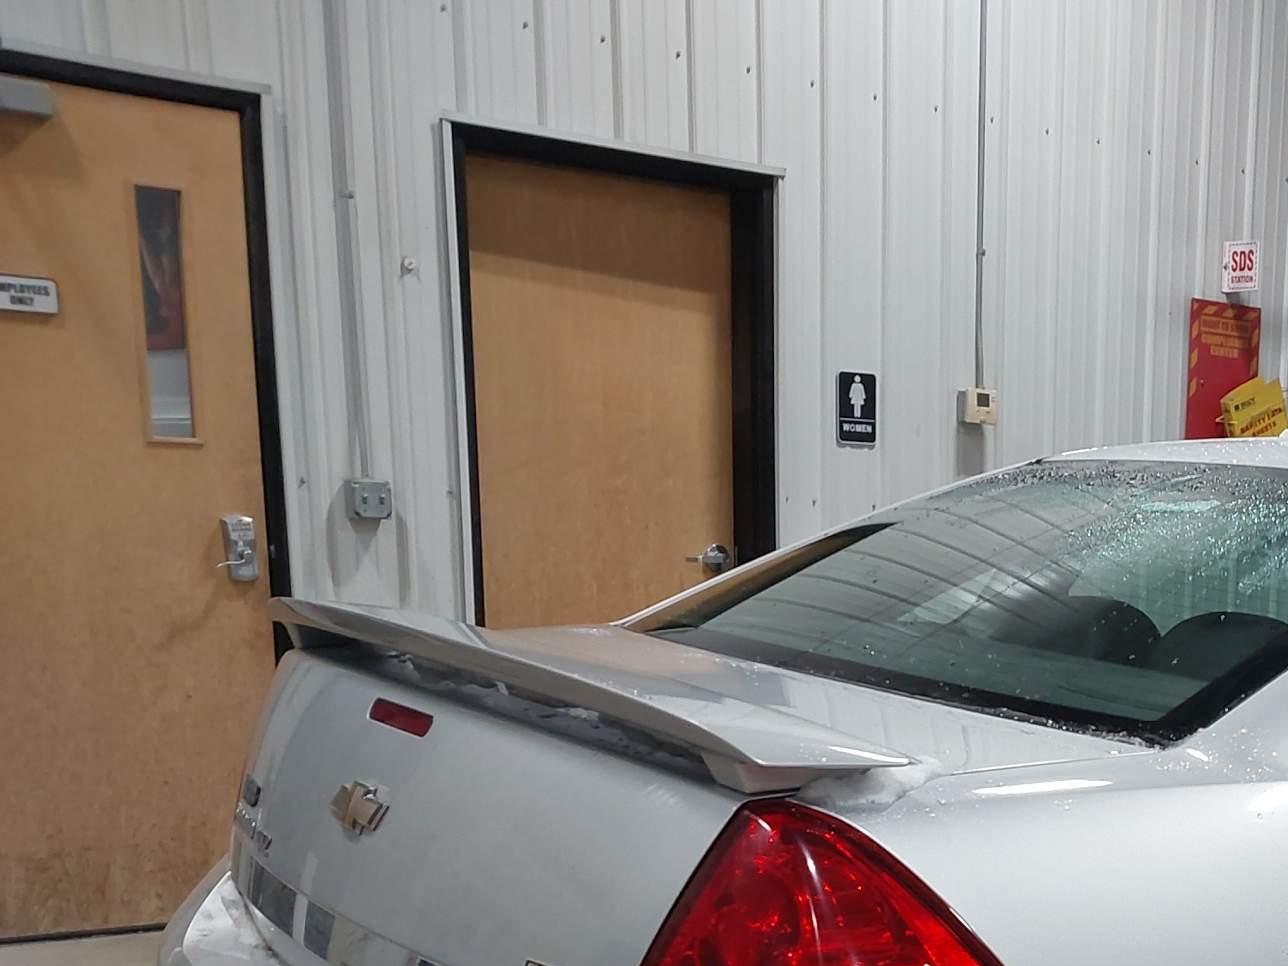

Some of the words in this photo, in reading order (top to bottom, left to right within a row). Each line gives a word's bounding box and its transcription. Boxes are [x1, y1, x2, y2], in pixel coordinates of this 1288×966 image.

[1231, 249, 1254, 272] SDS
[1231, 275, 1253, 284] STATION
[0, 282, 50, 296] MPLOYEES
[842, 423, 872, 433] WOMEN
